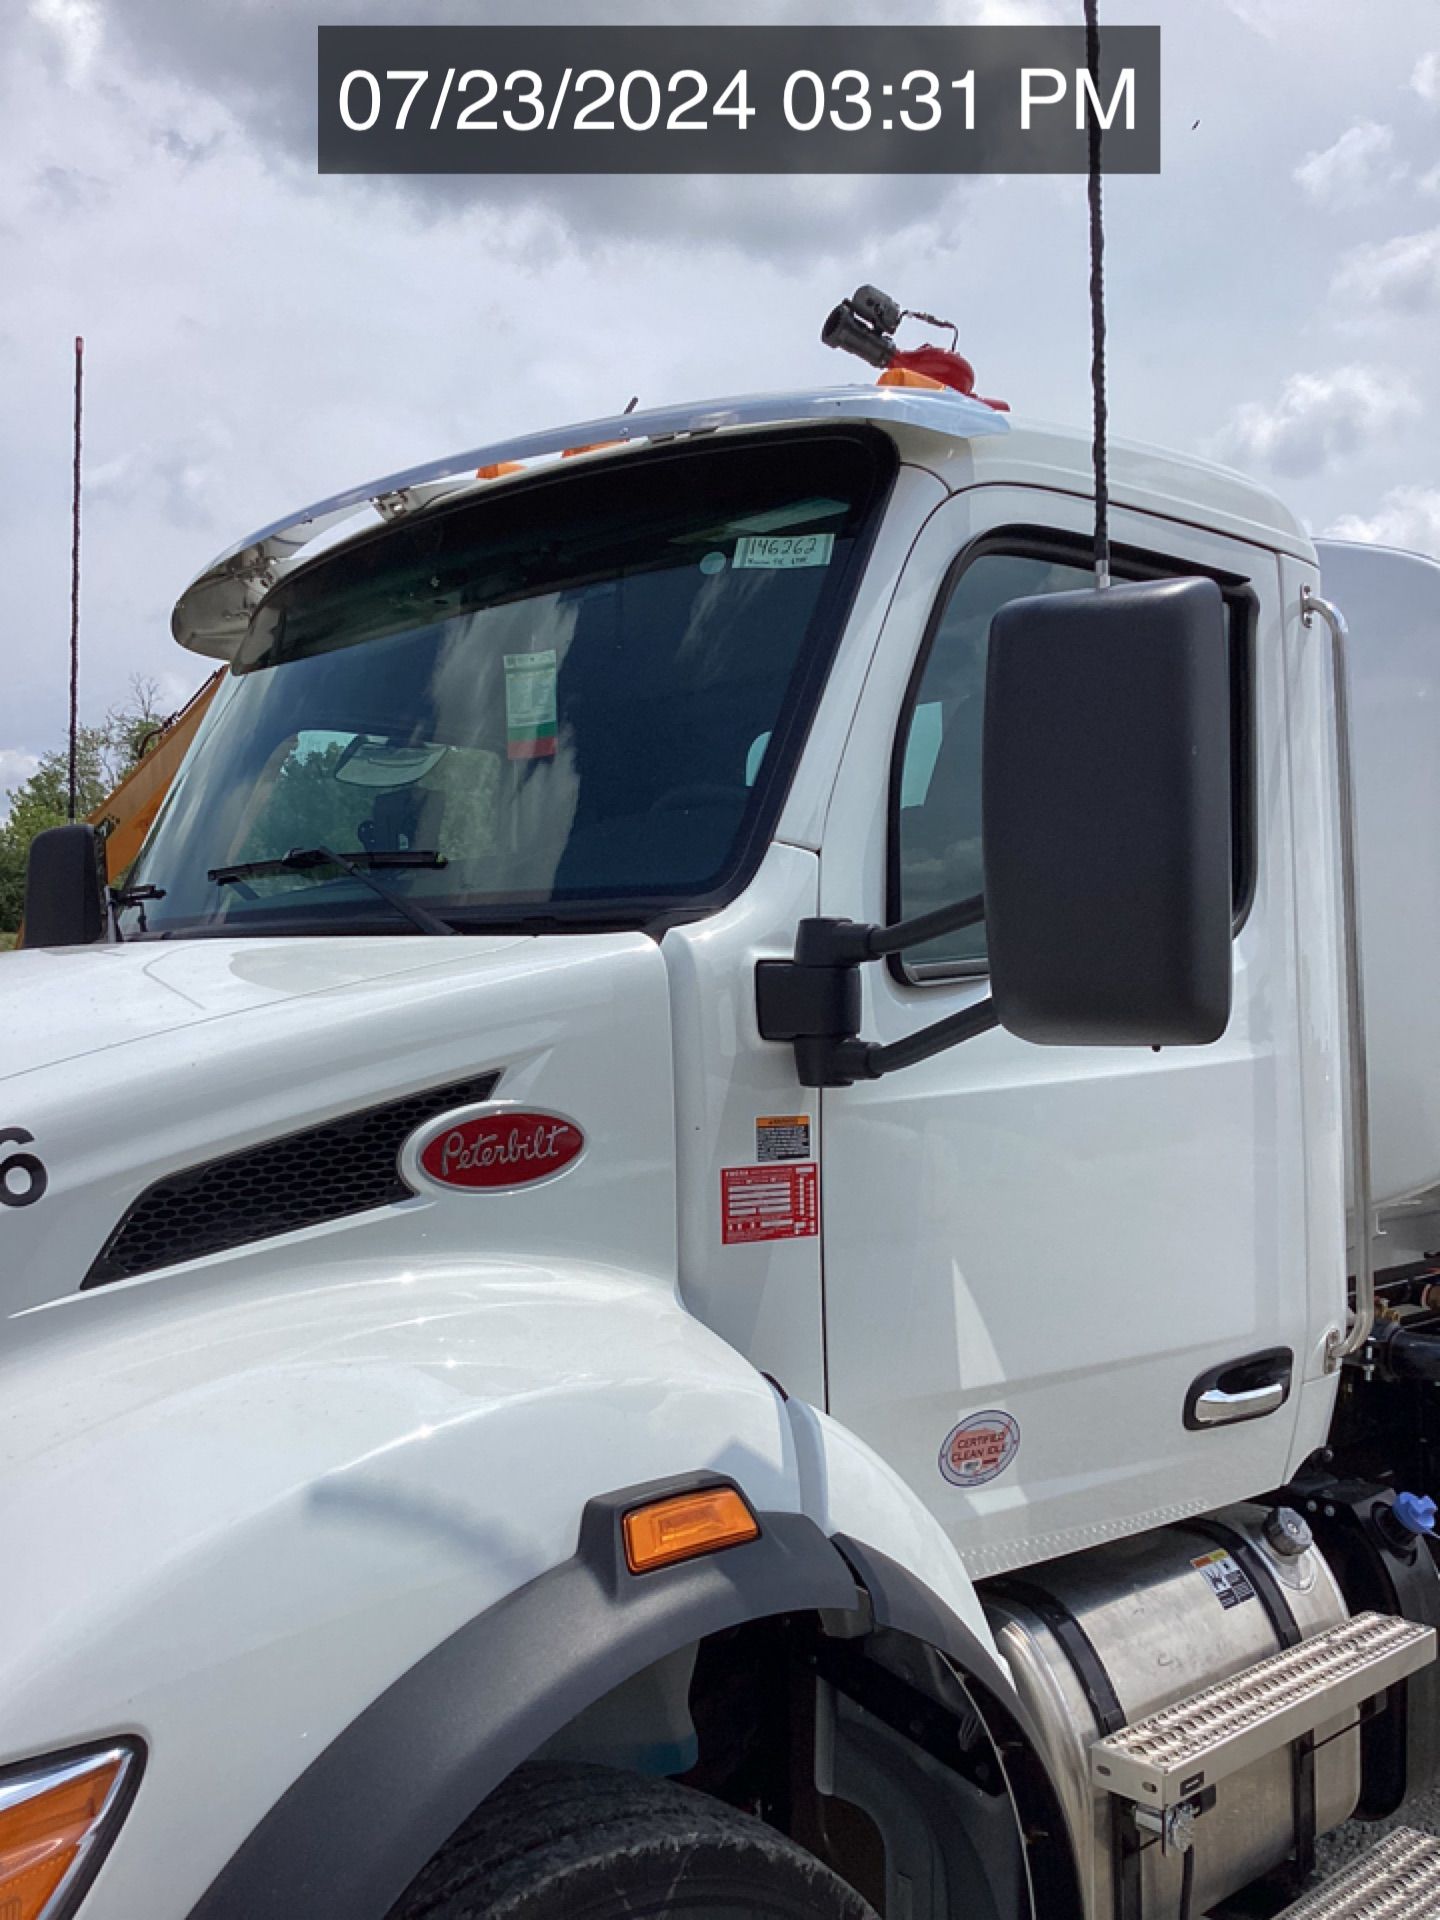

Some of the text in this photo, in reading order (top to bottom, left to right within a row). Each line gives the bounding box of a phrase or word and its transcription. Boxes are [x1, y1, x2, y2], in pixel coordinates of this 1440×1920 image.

[0, 1126, 48, 1208] 6
[441, 1124, 569, 1176] Peterbilt
[952, 1448, 985, 1462] CLEAN
[957, 1431, 1005, 1449] CERTIFIED
